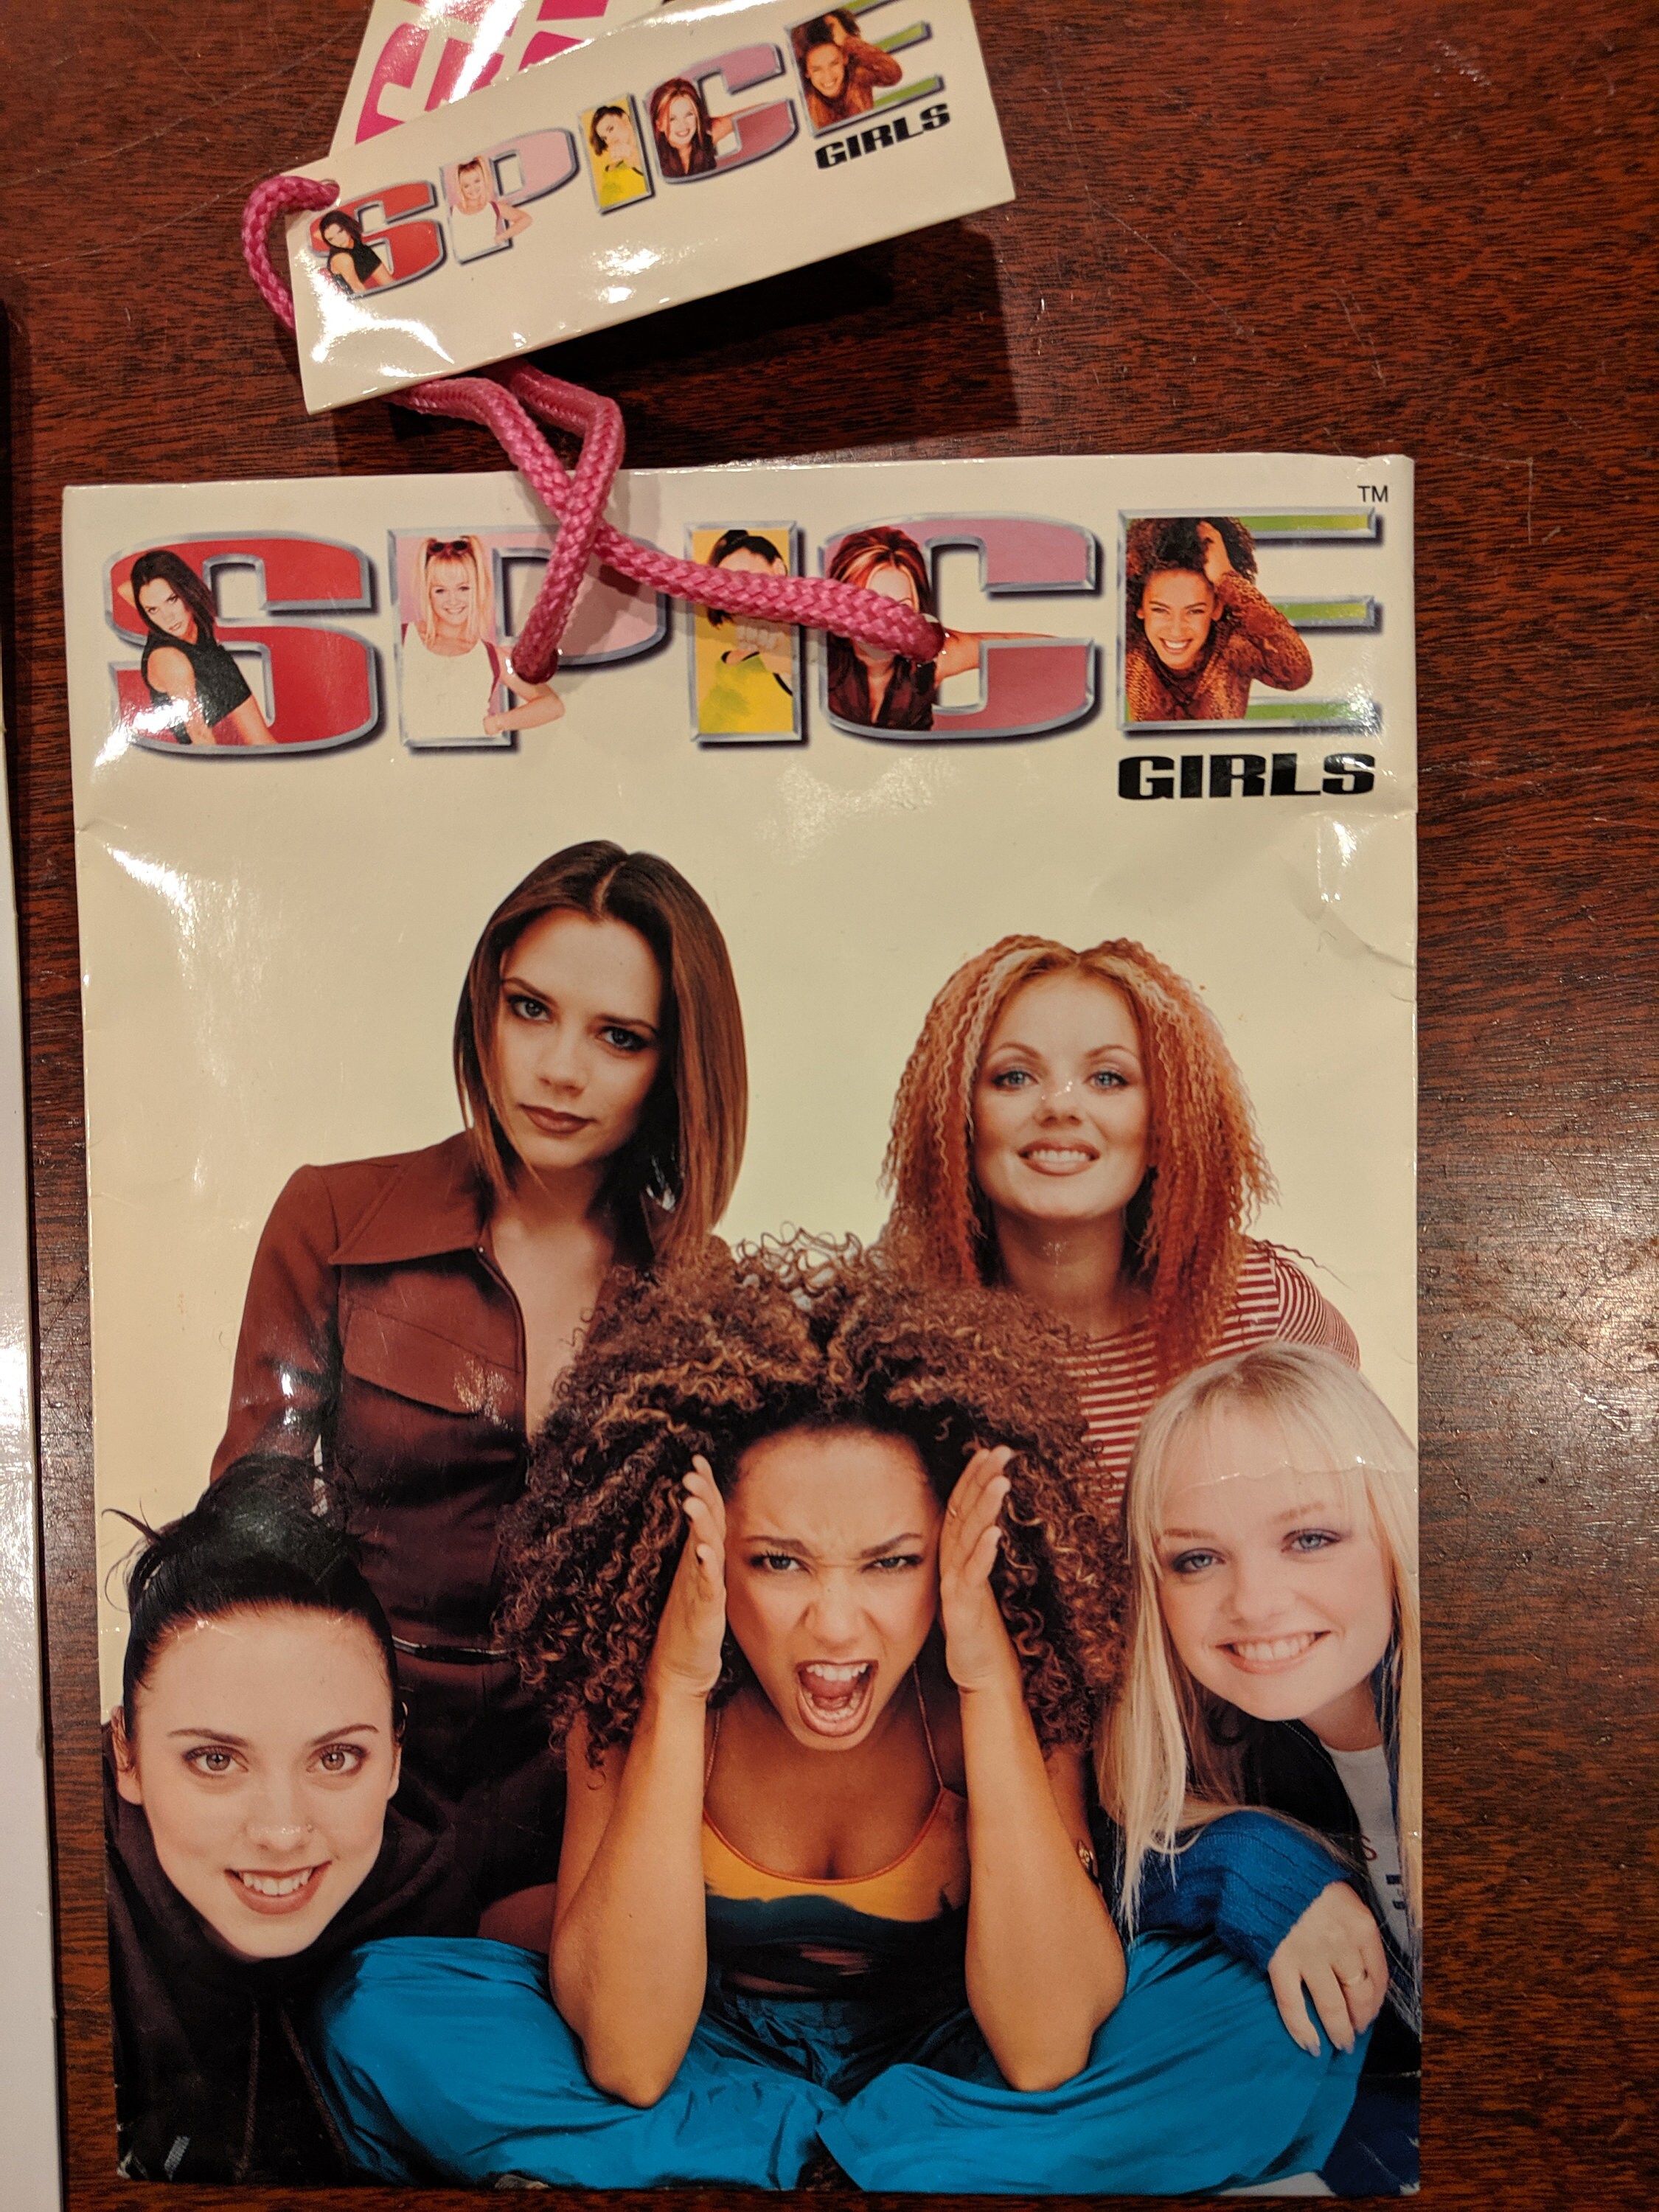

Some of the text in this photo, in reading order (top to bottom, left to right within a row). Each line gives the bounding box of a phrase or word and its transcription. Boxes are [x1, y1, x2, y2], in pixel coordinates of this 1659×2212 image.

[310, 0, 945, 299] SPICE
[815, 103, 950, 170] GIRLS
[1358, 486, 1389, 503] TM
[105, 507, 1383, 759] SPICE
[1119, 753, 1375, 801] GIRLS
